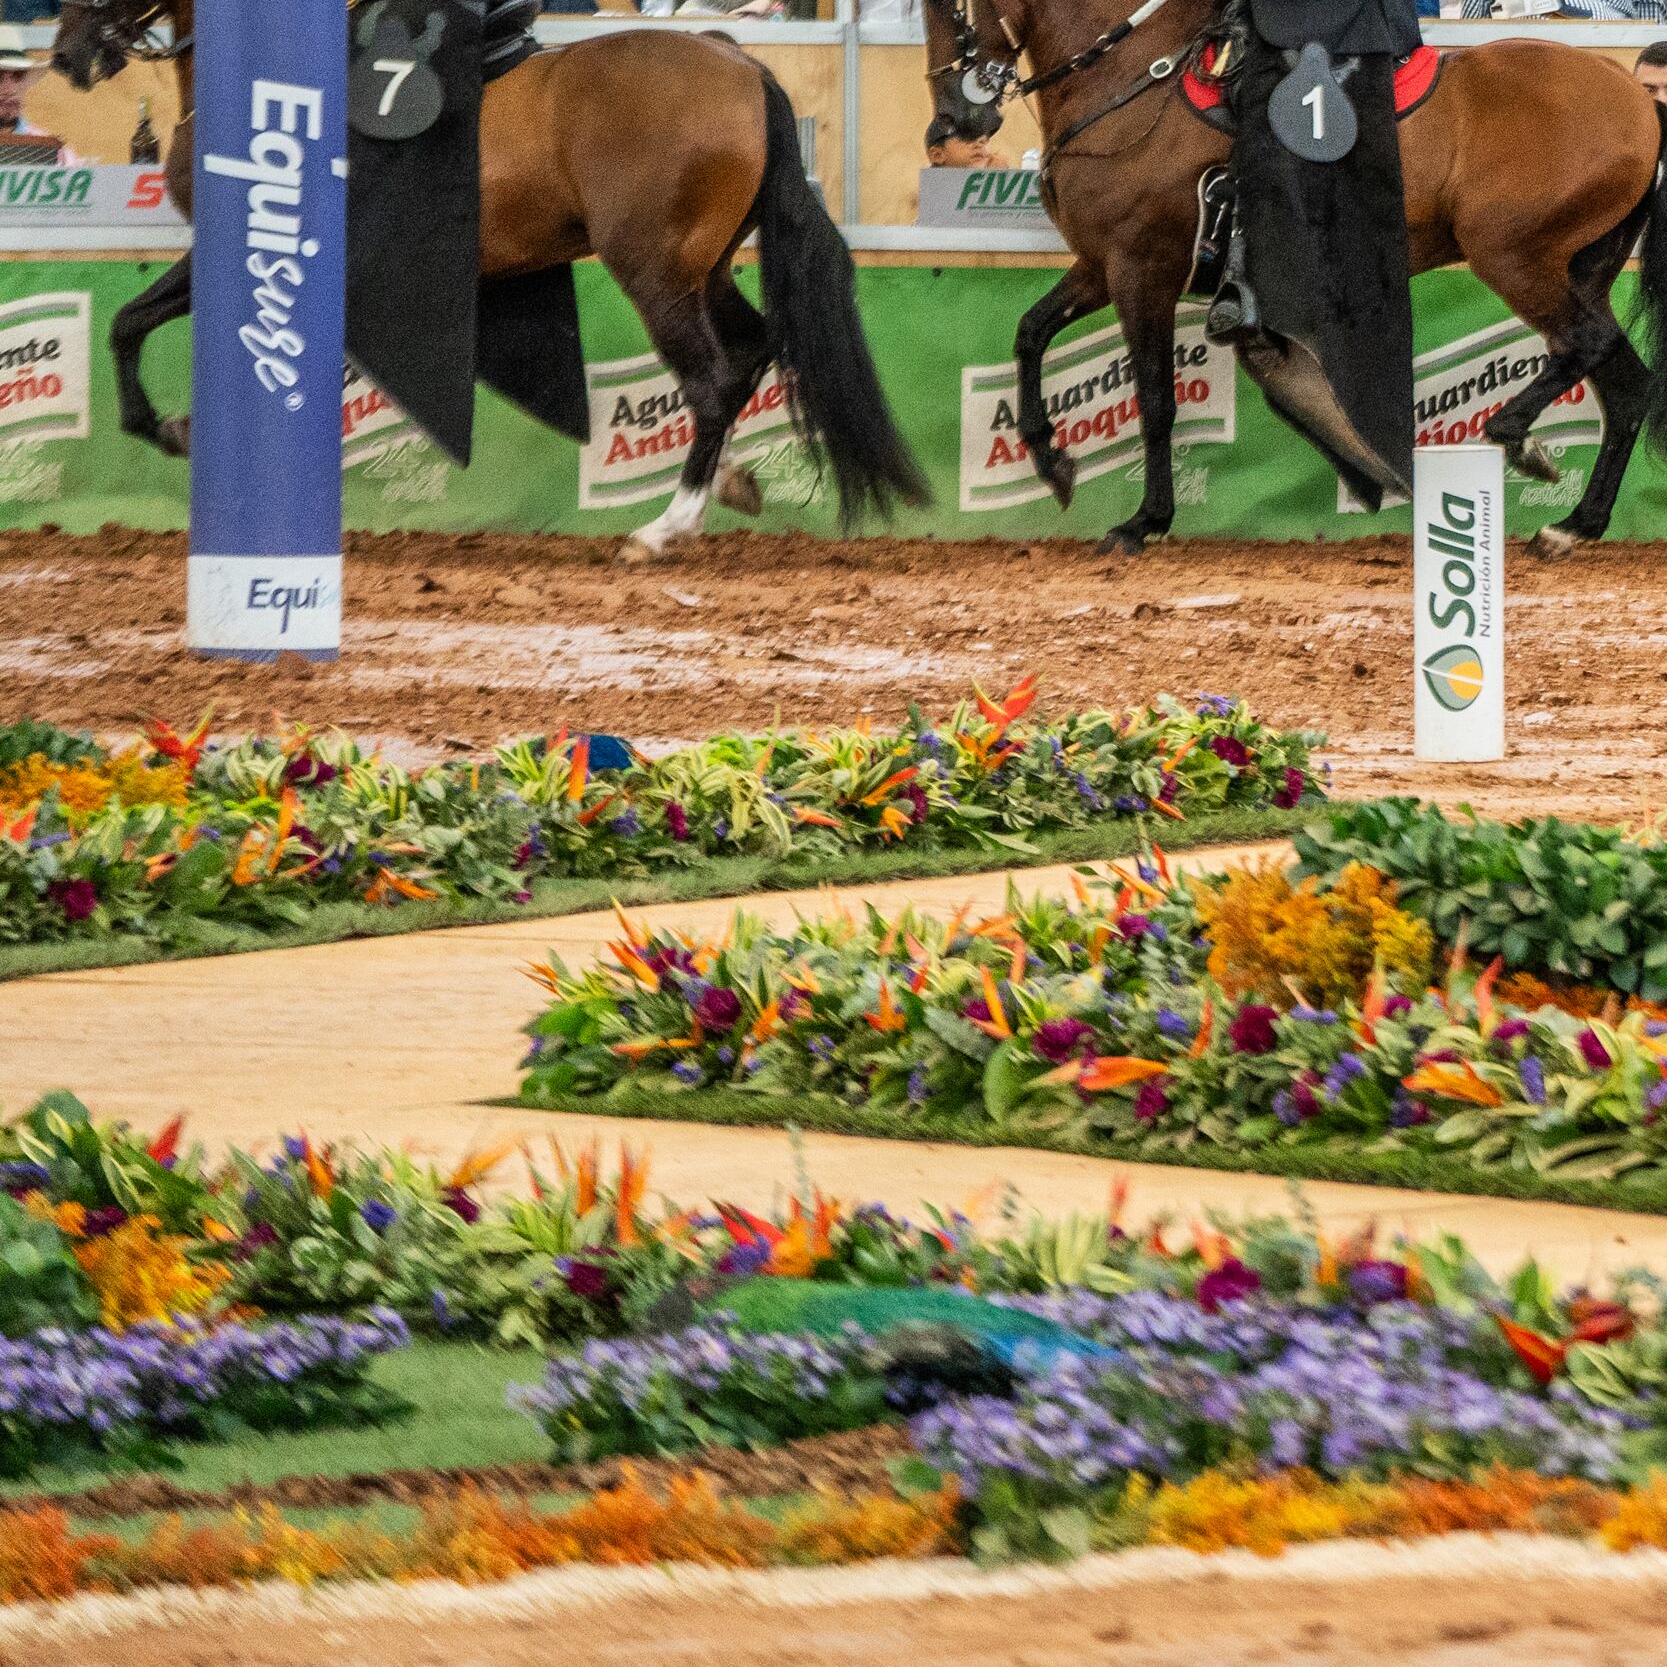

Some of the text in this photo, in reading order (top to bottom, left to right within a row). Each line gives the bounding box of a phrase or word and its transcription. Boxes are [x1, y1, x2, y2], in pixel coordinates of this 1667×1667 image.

[372, 59, 415, 117] 7
[1301, 84, 1325, 140] 1
[203, 79, 322, 394] Equisure
[247, 577, 332, 634] Equi
[1427, 490, 1476, 639] Solla
[1478, 489, 1492, 638] Nutrición Animal
